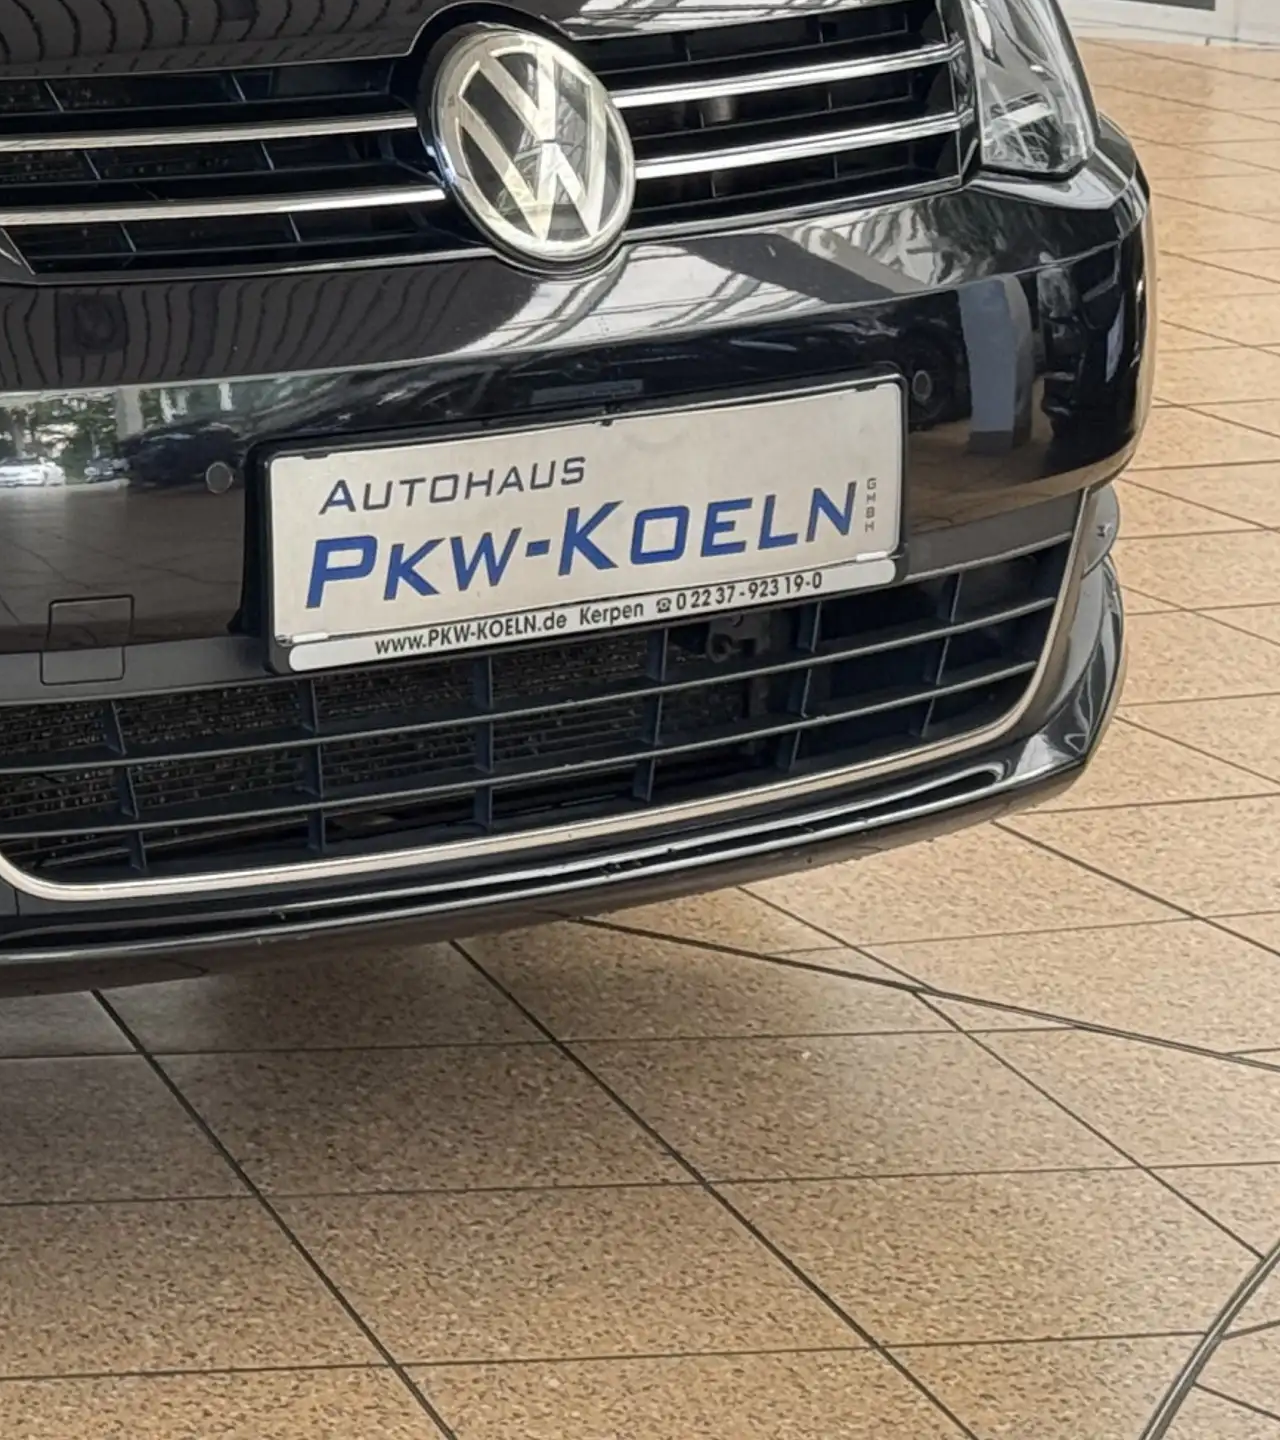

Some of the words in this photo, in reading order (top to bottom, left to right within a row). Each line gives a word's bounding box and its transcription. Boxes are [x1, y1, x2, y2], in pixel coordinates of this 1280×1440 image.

[431, 30, 636, 260] VW
[318, 456, 586, 515] AUTOHAUS
[306, 481, 856, 609] PKW-KOELN
[375, 613, 567, 655] www.PKW-KOELN.de
[579, 602, 644, 627] Kerpen
